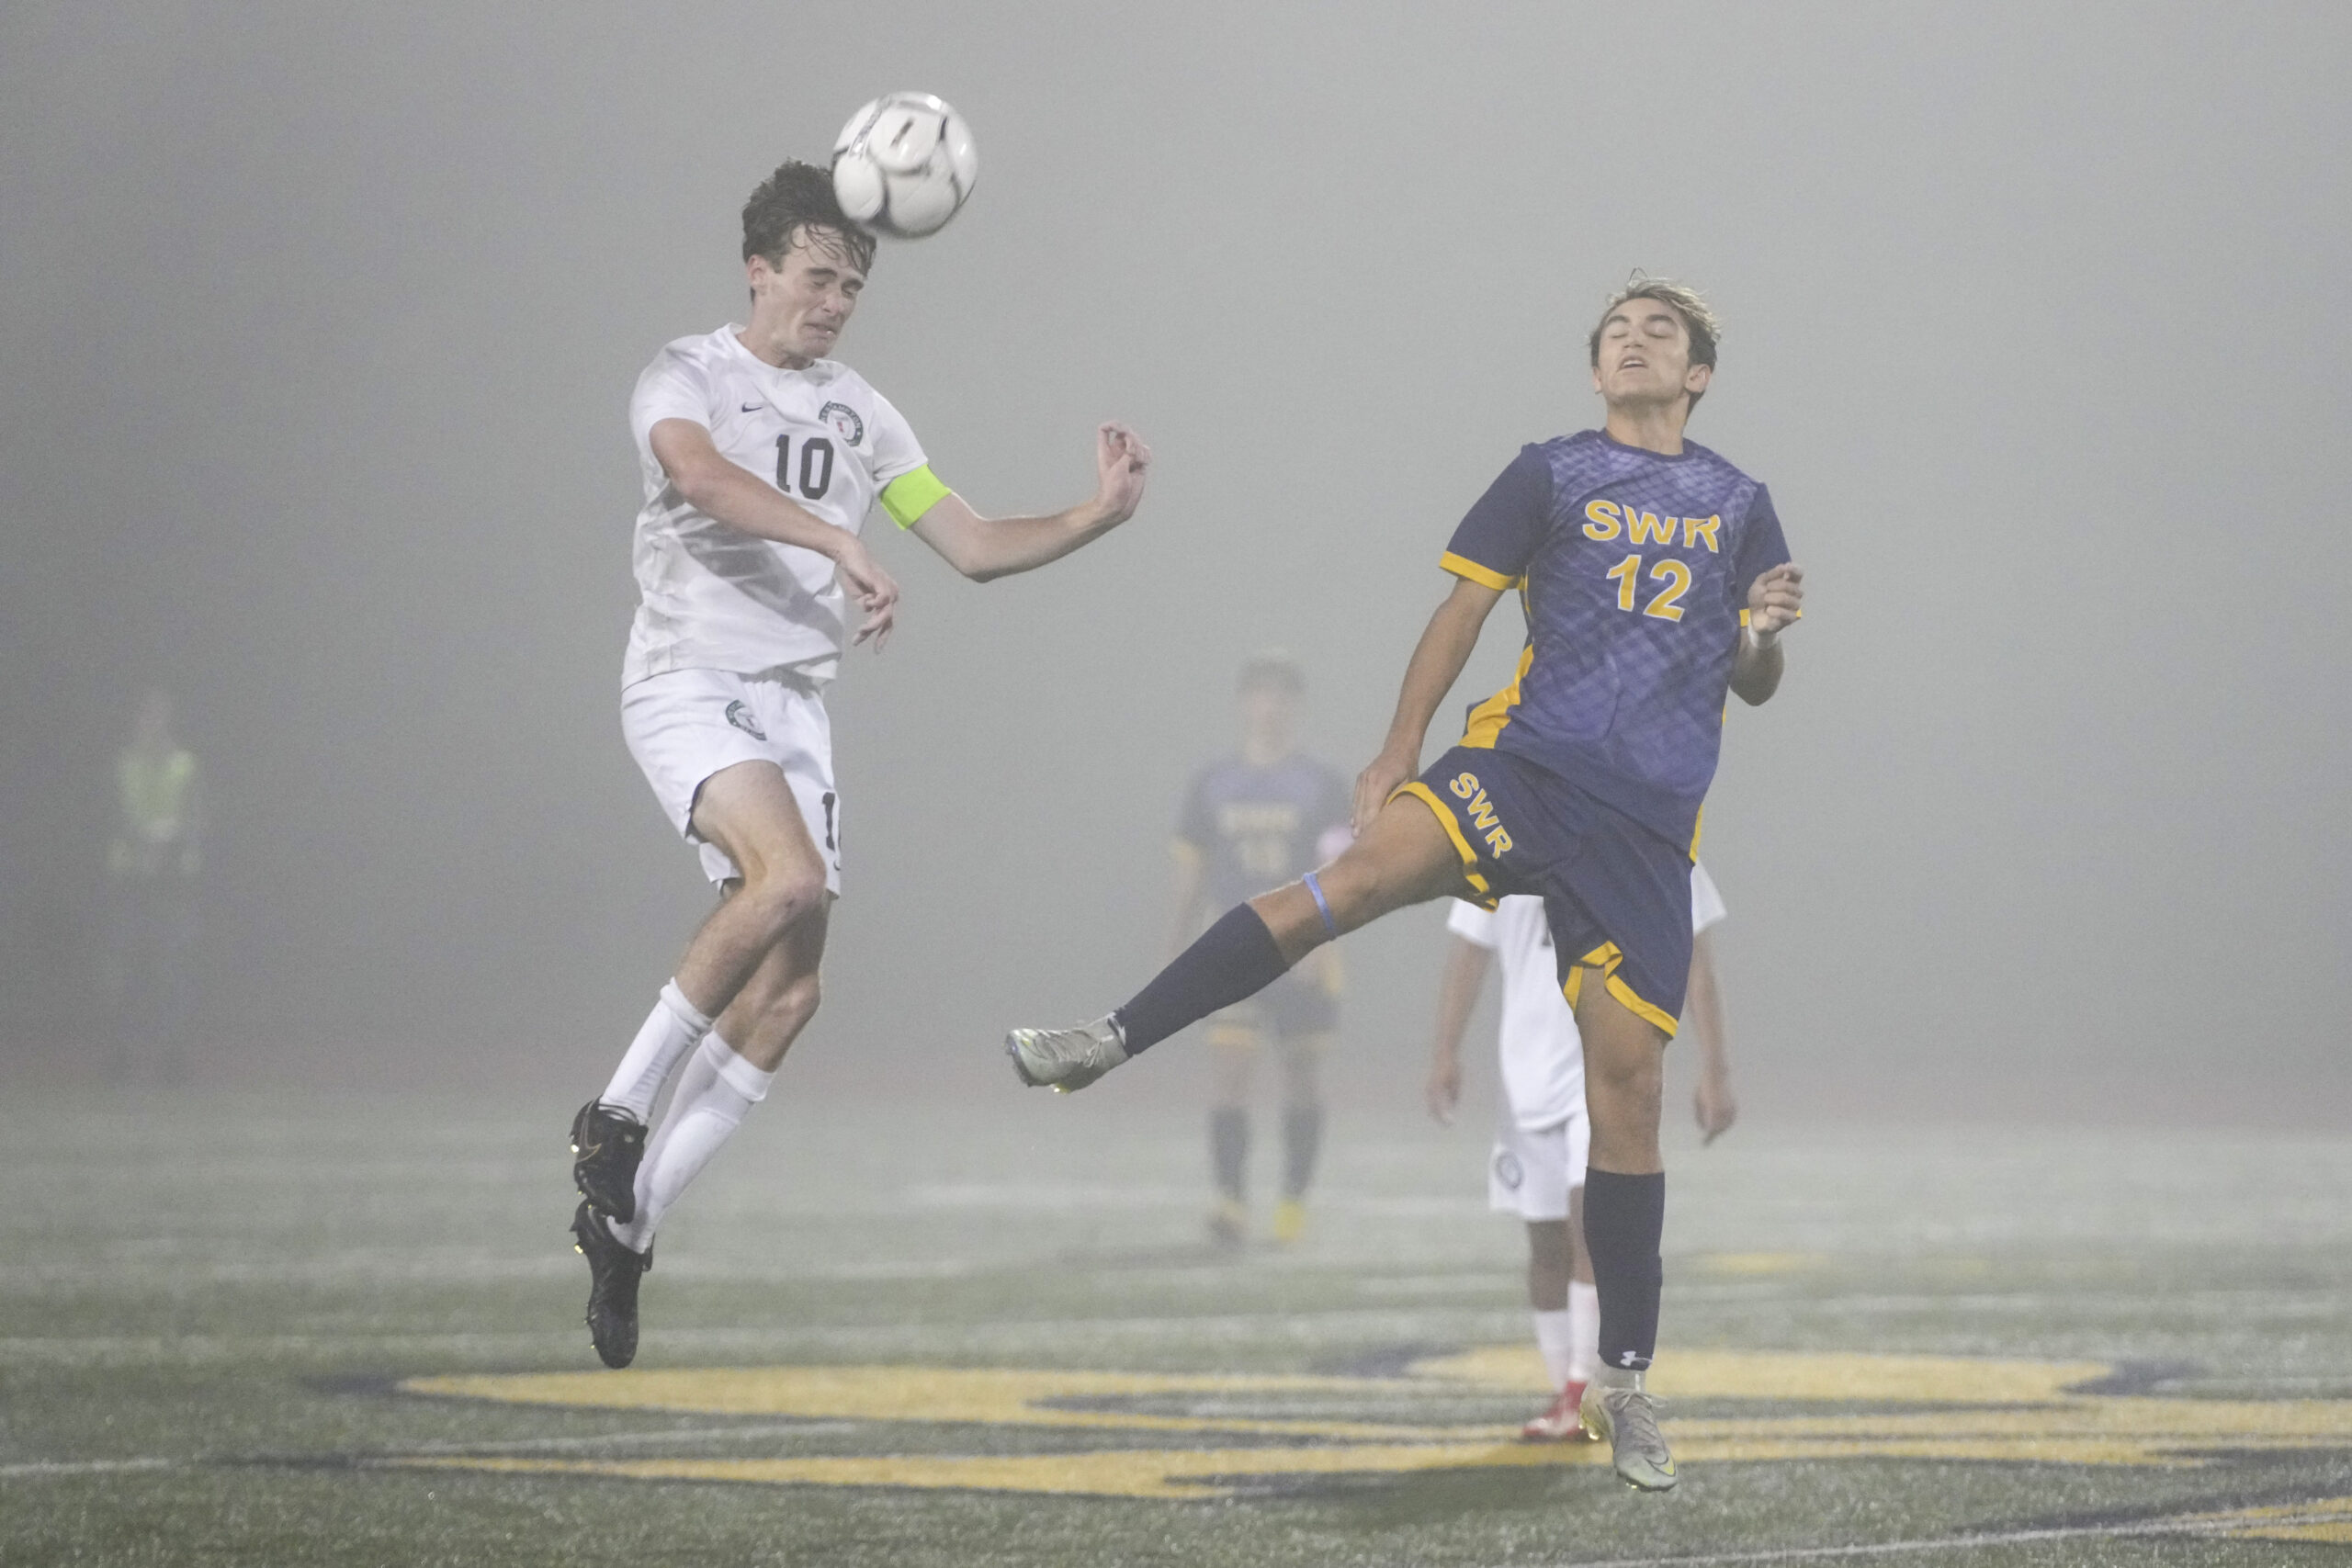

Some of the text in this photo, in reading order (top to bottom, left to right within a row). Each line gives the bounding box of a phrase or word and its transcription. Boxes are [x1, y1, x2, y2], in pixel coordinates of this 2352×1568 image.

[775, 434, 834, 501] 10
[1582, 499, 1721, 553] SWR
[1606, 554, 1691, 623] 12
[1449, 772, 1513, 859] SWR
